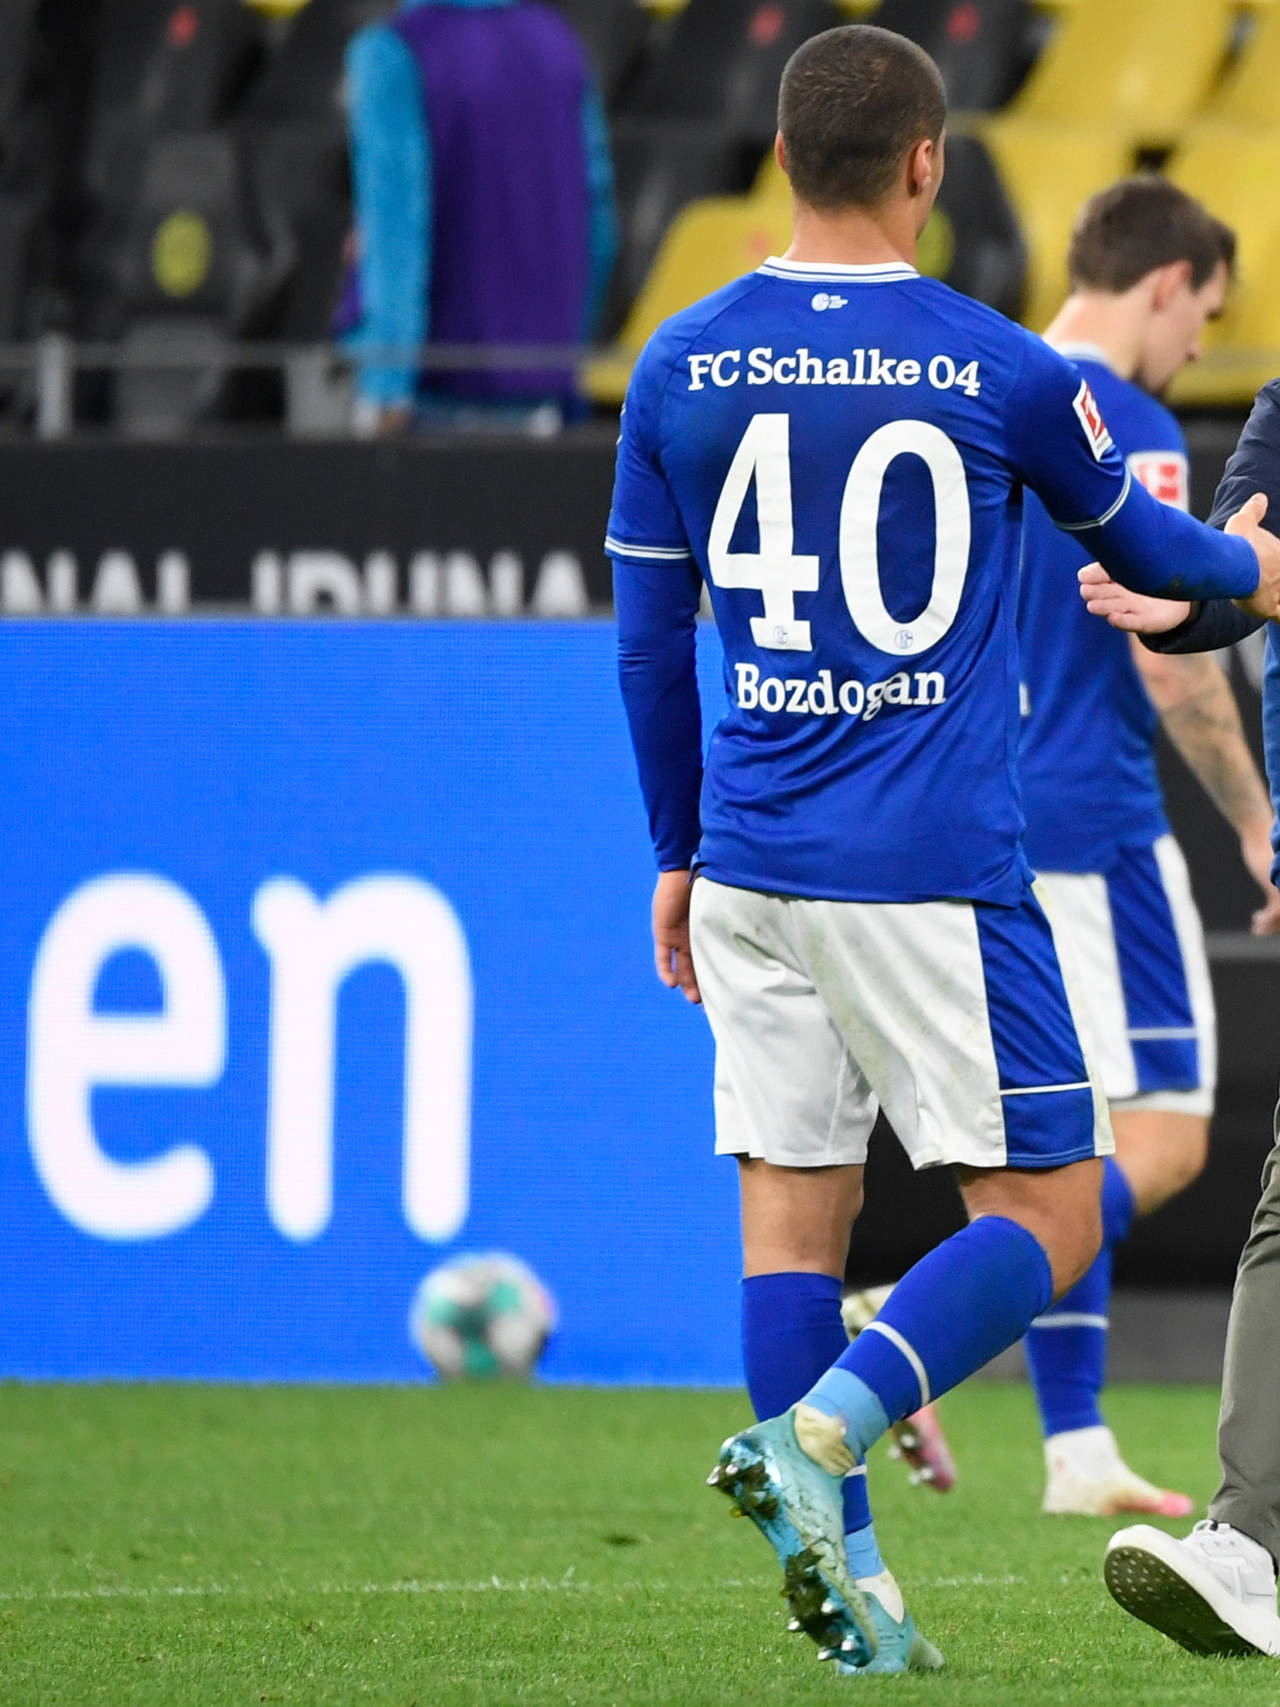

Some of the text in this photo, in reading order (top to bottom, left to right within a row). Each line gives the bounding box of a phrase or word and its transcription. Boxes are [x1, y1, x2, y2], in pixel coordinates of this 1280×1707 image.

[687, 347, 981, 397] FC Schalke 04
[706, 412, 972, 656] 40
[734, 662, 947, 721] Bozdogan
[26, 871, 474, 1244] en
